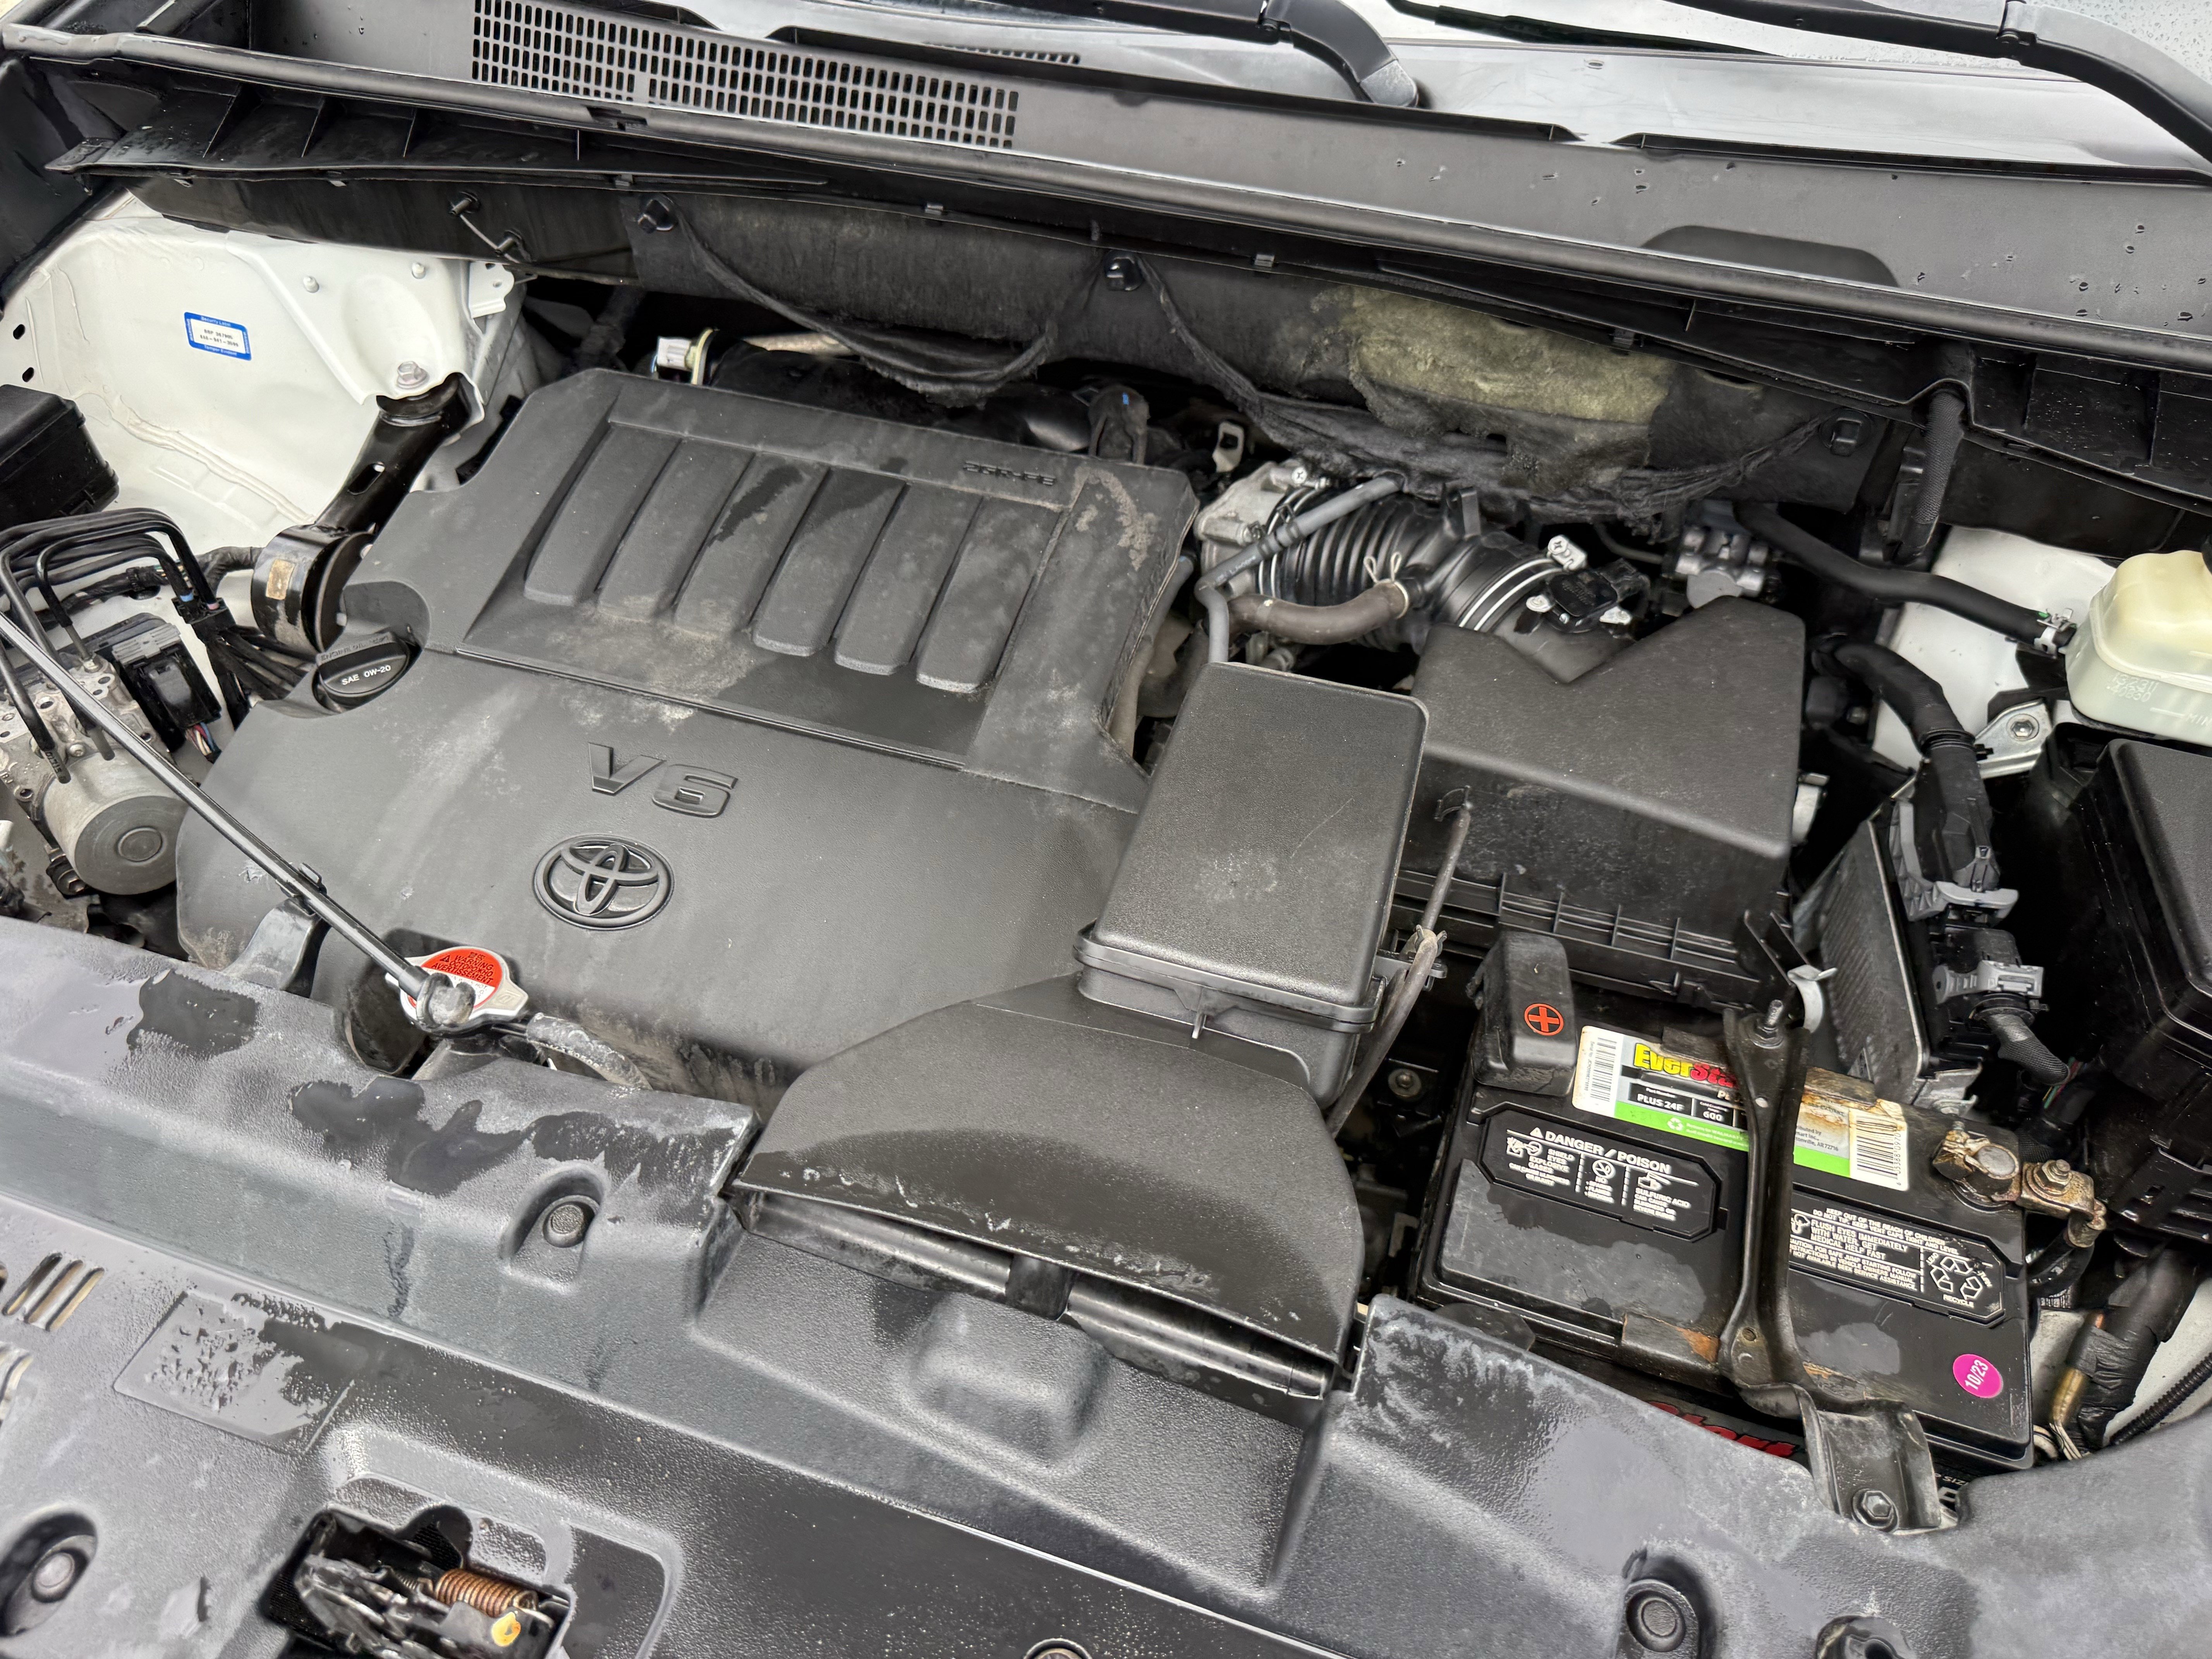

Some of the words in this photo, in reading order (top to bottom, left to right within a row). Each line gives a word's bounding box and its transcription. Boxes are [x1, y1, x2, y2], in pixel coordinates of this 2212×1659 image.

[342, 674, 360, 685] SAE
[588, 742, 738, 818] V6
[431, 962, 494, 984] AVERTISSEMENT
[1633, 1043, 1739, 1089] EverSta
[1637, 1093, 1664, 1107] PLUS
[1664, 1101, 1685, 1112] 24F
[1703, 1111, 1724, 1121] 600
[1545, 1131, 1605, 1156] DANGER
[1617, 1151, 1673, 1175] POISON
[1547, 1149, 1576, 1162] SHIELD
[1547, 1154, 1568, 1165] EYES
[1528, 1161, 1554, 1175] GASES
[1529, 1156, 1570, 1173] EXPLOSIVE
[1595, 1175, 1609, 1185] NO
[1635, 1187, 1672, 1204] SULFURIC
[1671, 1198, 1692, 1209] ACID
[1813, 1209, 1823, 1217] DO
[1823, 1212, 1837, 1221] NOT
[1851, 1221, 1869, 1230] KEEP
[1869, 1225, 1886, 1235] VENT
[1886, 1230, 1905, 1240] CAPS
[1905, 1235, 1924, 1245] TIGHT
[1925, 1241, 1939, 1250] AND
[1826, 1207, 1843, 1217] KEEP
[1843, 1212, 1858, 1221] OUT
[1858, 1216, 1869, 1224] OF
[1869, 1219, 1881, 1228] THE
[1882, 1223, 1904, 1234] REACH
[1810, 1226, 1832, 1238] WITH
[1861, 1240, 1877, 1250] GET
[1810, 1233, 1844, 1250] MEDICAL
[1844, 1242, 1867, 1255] HELP
[1866, 1249, 1887, 1261] FAST
[1811, 1219, 1837, 1233] FLUSH
[1836, 1226, 1858, 1238] EYES
[1858, 1232, 1908, 1253] IMMEDIATELY
[1789, 1243, 1830, 1260] NSTRUCTIONS
[1838, 1257, 1862, 1270] VEHICLE
[1792, 1250, 1807, 1259] NOT
[1806, 1254, 1837, 1269] AVAILABLE
[1837, 1263, 1854, 1274] SEEK
[1853, 1267, 1879, 1281] SERVICE
[1814, 1245, 1828, 1254] FOR
[1827, 1249, 1844, 1259] SAFE
[1844, 1254, 1862, 1264] JUMP
[1861, 1259, 1891, 1272] STARTING
[1892, 1267, 1917, 1279] FOLLOW
[1925, 1252, 1939, 1266] LEAD
[1943, 1293, 1975, 1309] RECYCLE
[1964, 1359, 1989, 1390] 10/23
[1942, 1476, 1969, 1486] SIZ
